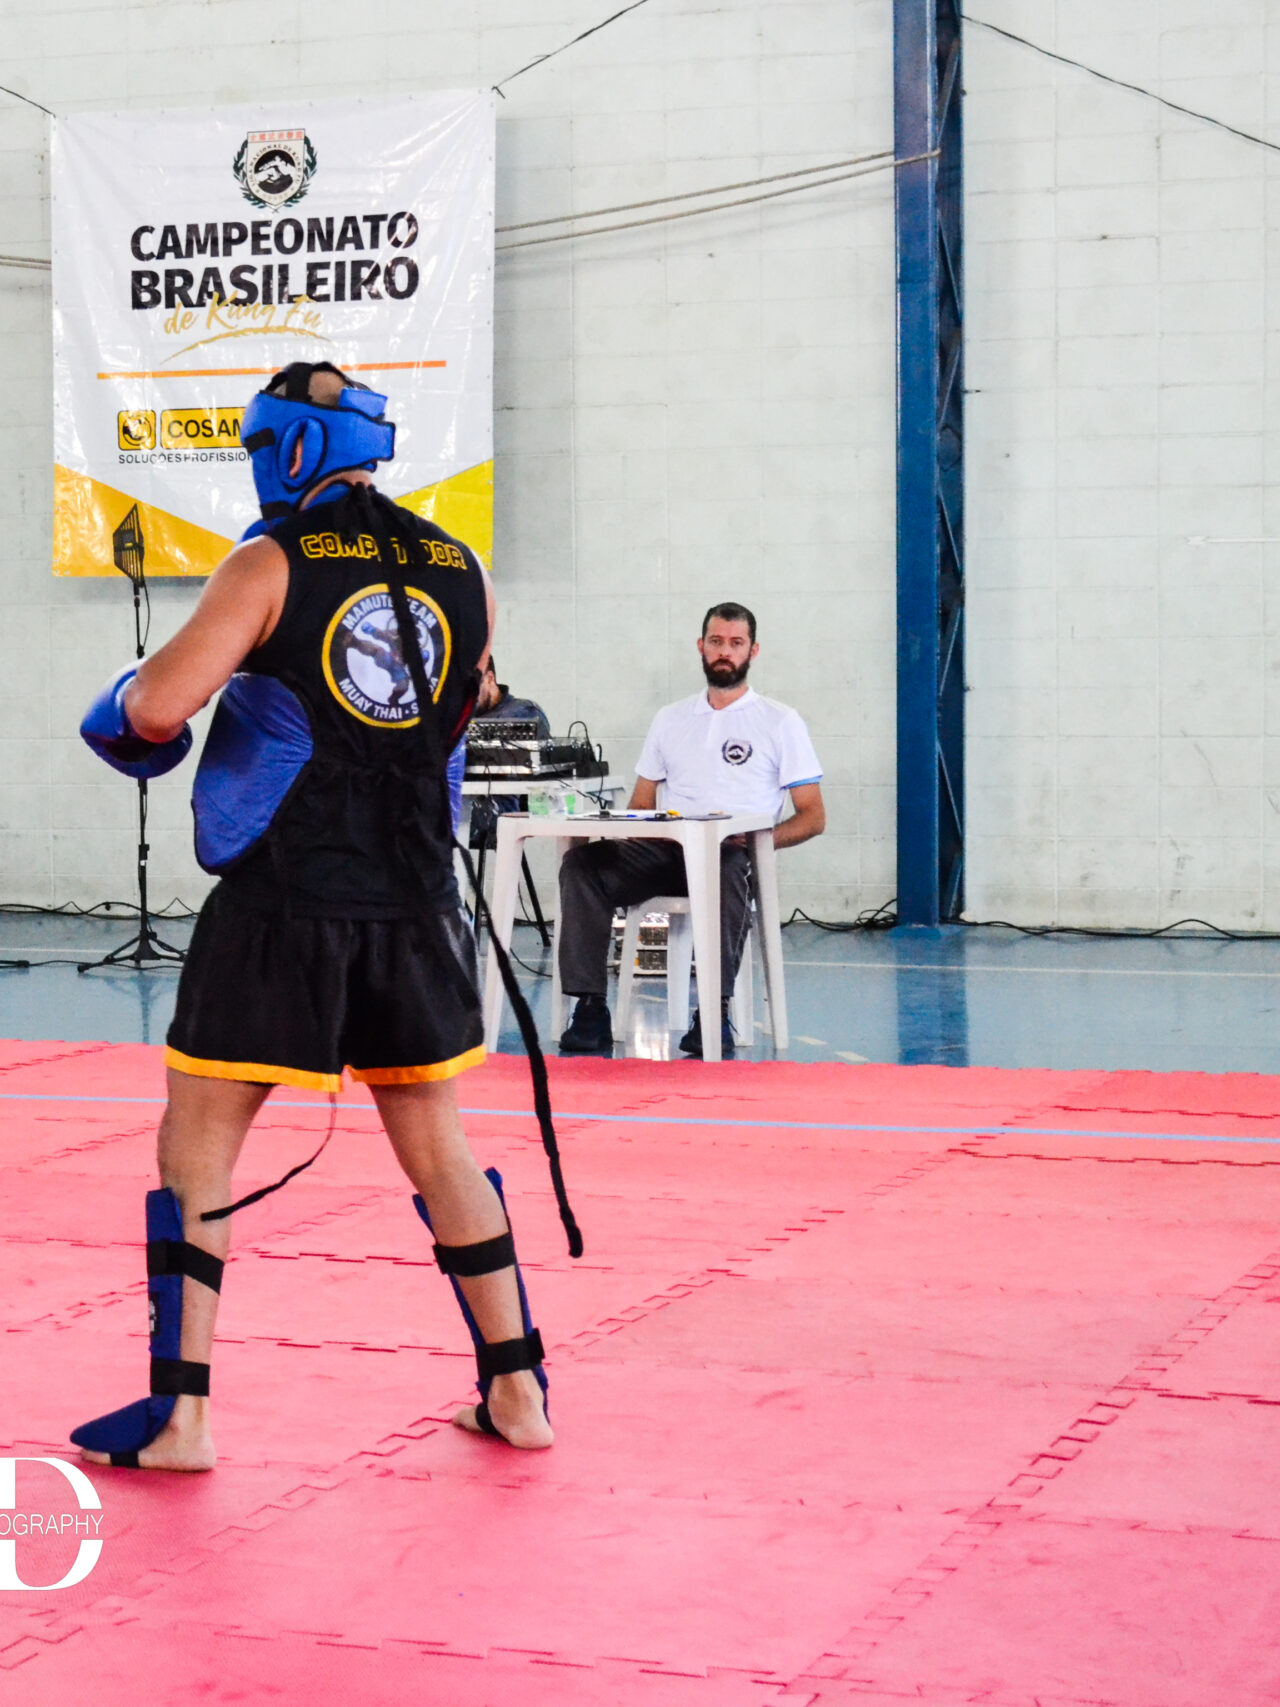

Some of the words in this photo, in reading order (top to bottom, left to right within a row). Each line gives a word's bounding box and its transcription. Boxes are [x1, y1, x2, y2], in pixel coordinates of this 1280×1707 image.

[130, 211, 419, 261] CAMPEONATO
[131, 256, 419, 310] BRASILEIRO
[164, 302, 197, 334] de
[206, 290, 277, 330] Kung
[285, 294, 323, 328] Fu
[407, 598, 437, 629] EAM
[338, 678, 373, 712] MUAY
[373, 704, 402, 719] THAI
